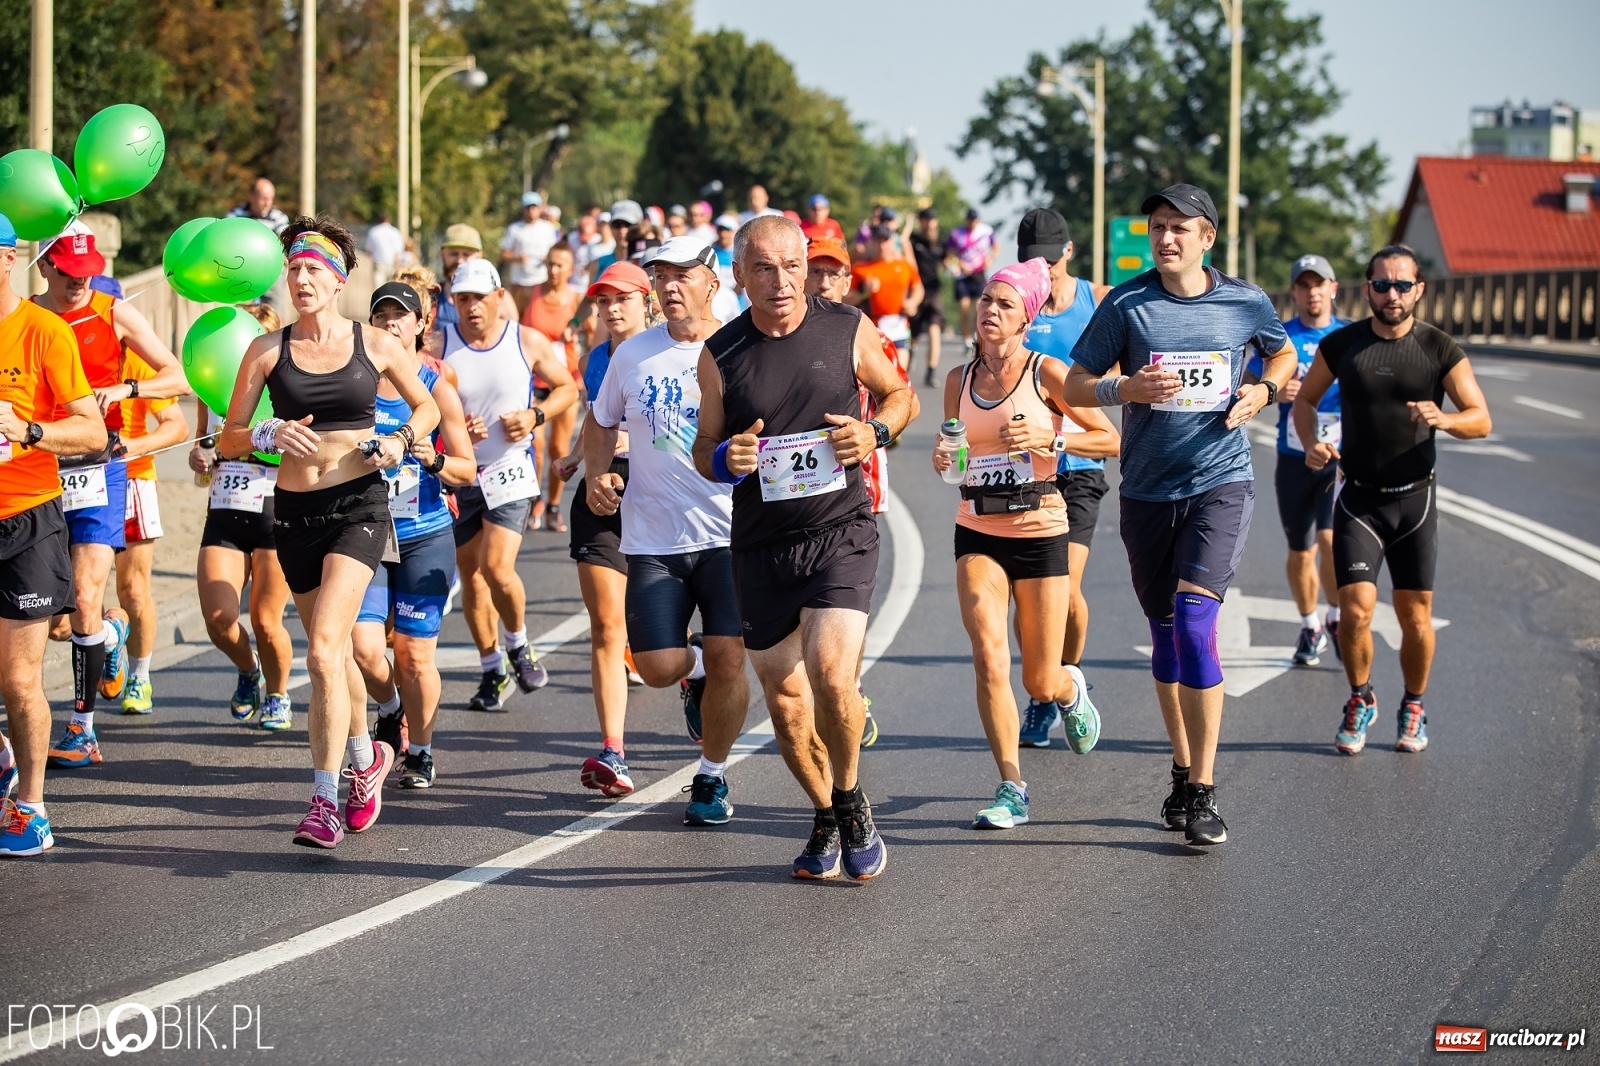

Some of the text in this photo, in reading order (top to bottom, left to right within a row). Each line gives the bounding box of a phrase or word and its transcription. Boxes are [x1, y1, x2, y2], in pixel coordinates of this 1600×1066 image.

[790, 449, 818, 472] 26
[223, 474, 250, 490] 353
[498, 466, 525, 485] 352
[981, 469, 1016, 487] 228
[19, 596, 52, 610] BIEGOWY
